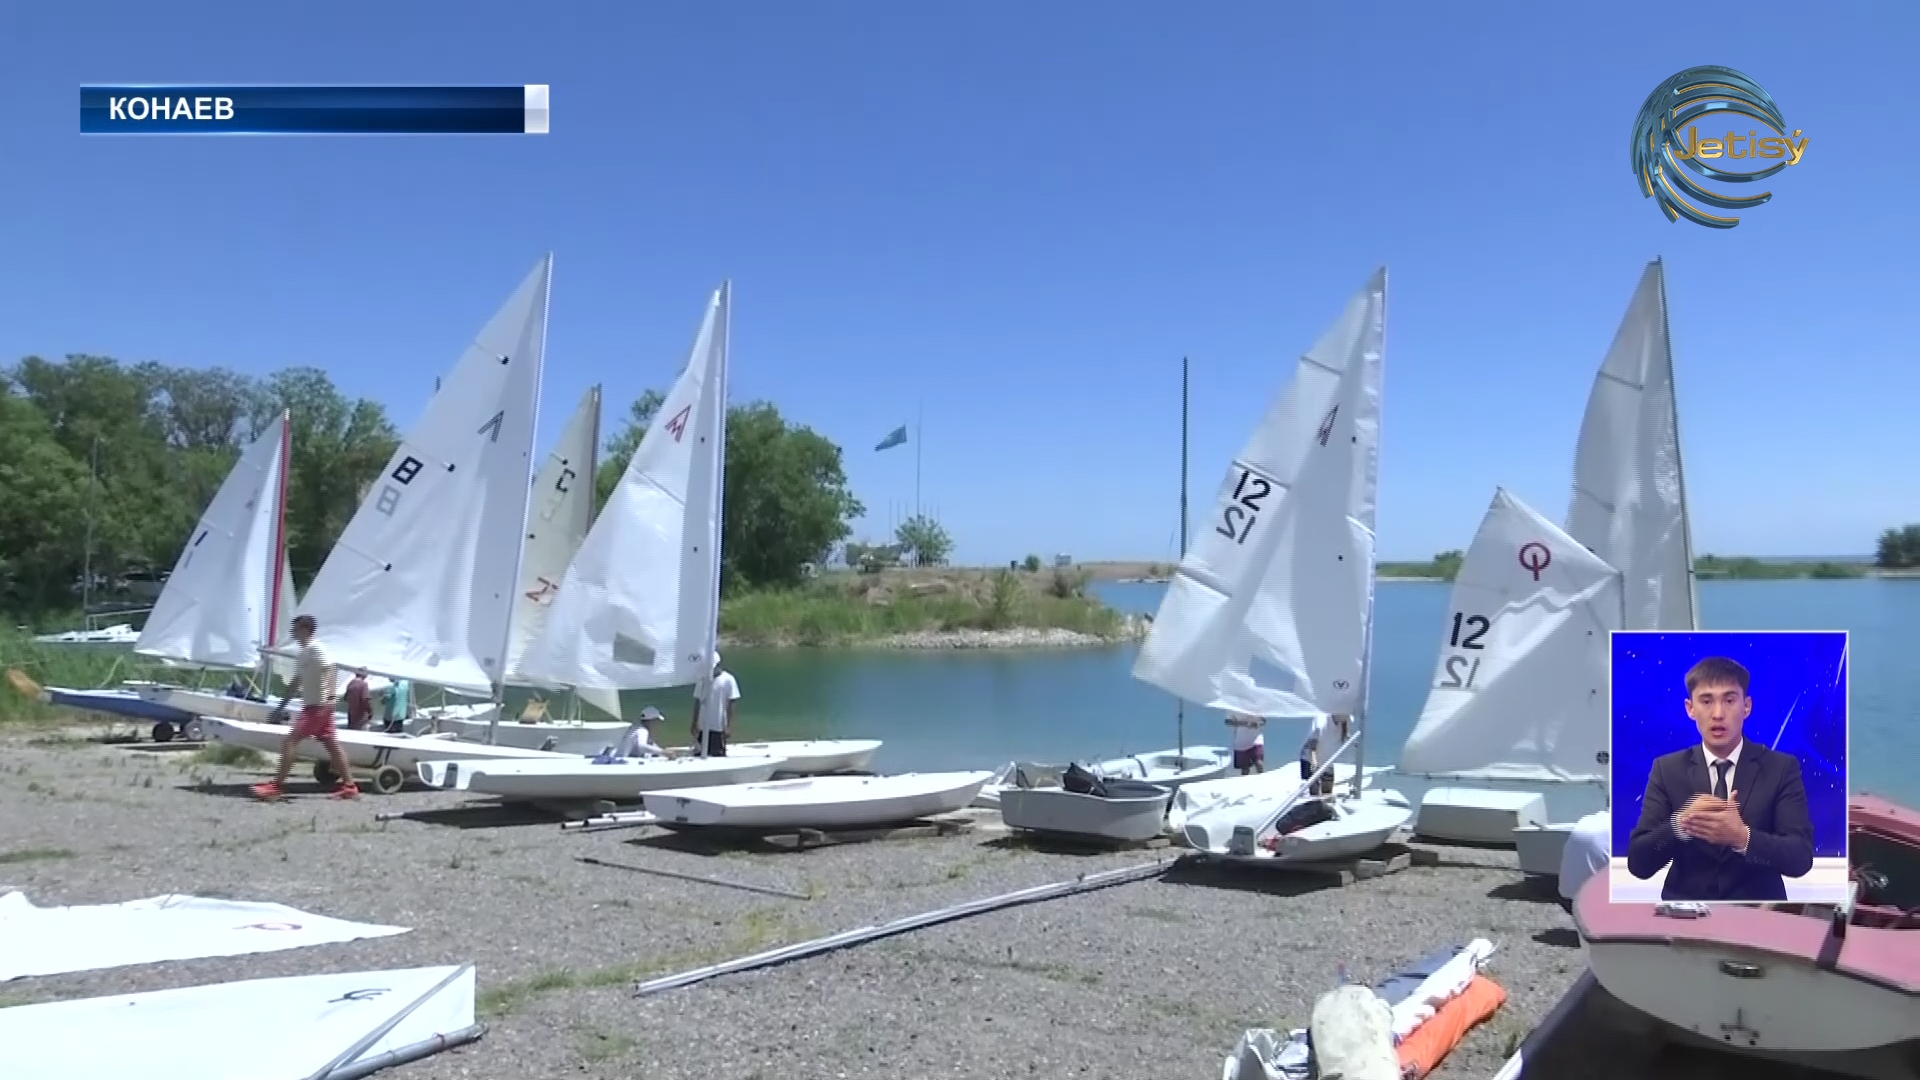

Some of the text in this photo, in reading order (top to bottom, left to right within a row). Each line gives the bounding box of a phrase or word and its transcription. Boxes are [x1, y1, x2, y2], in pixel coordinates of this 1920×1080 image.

[391, 455, 424, 485] 8
[1232, 470, 1271, 512] 12
[1450, 612, 1490, 650] 12
